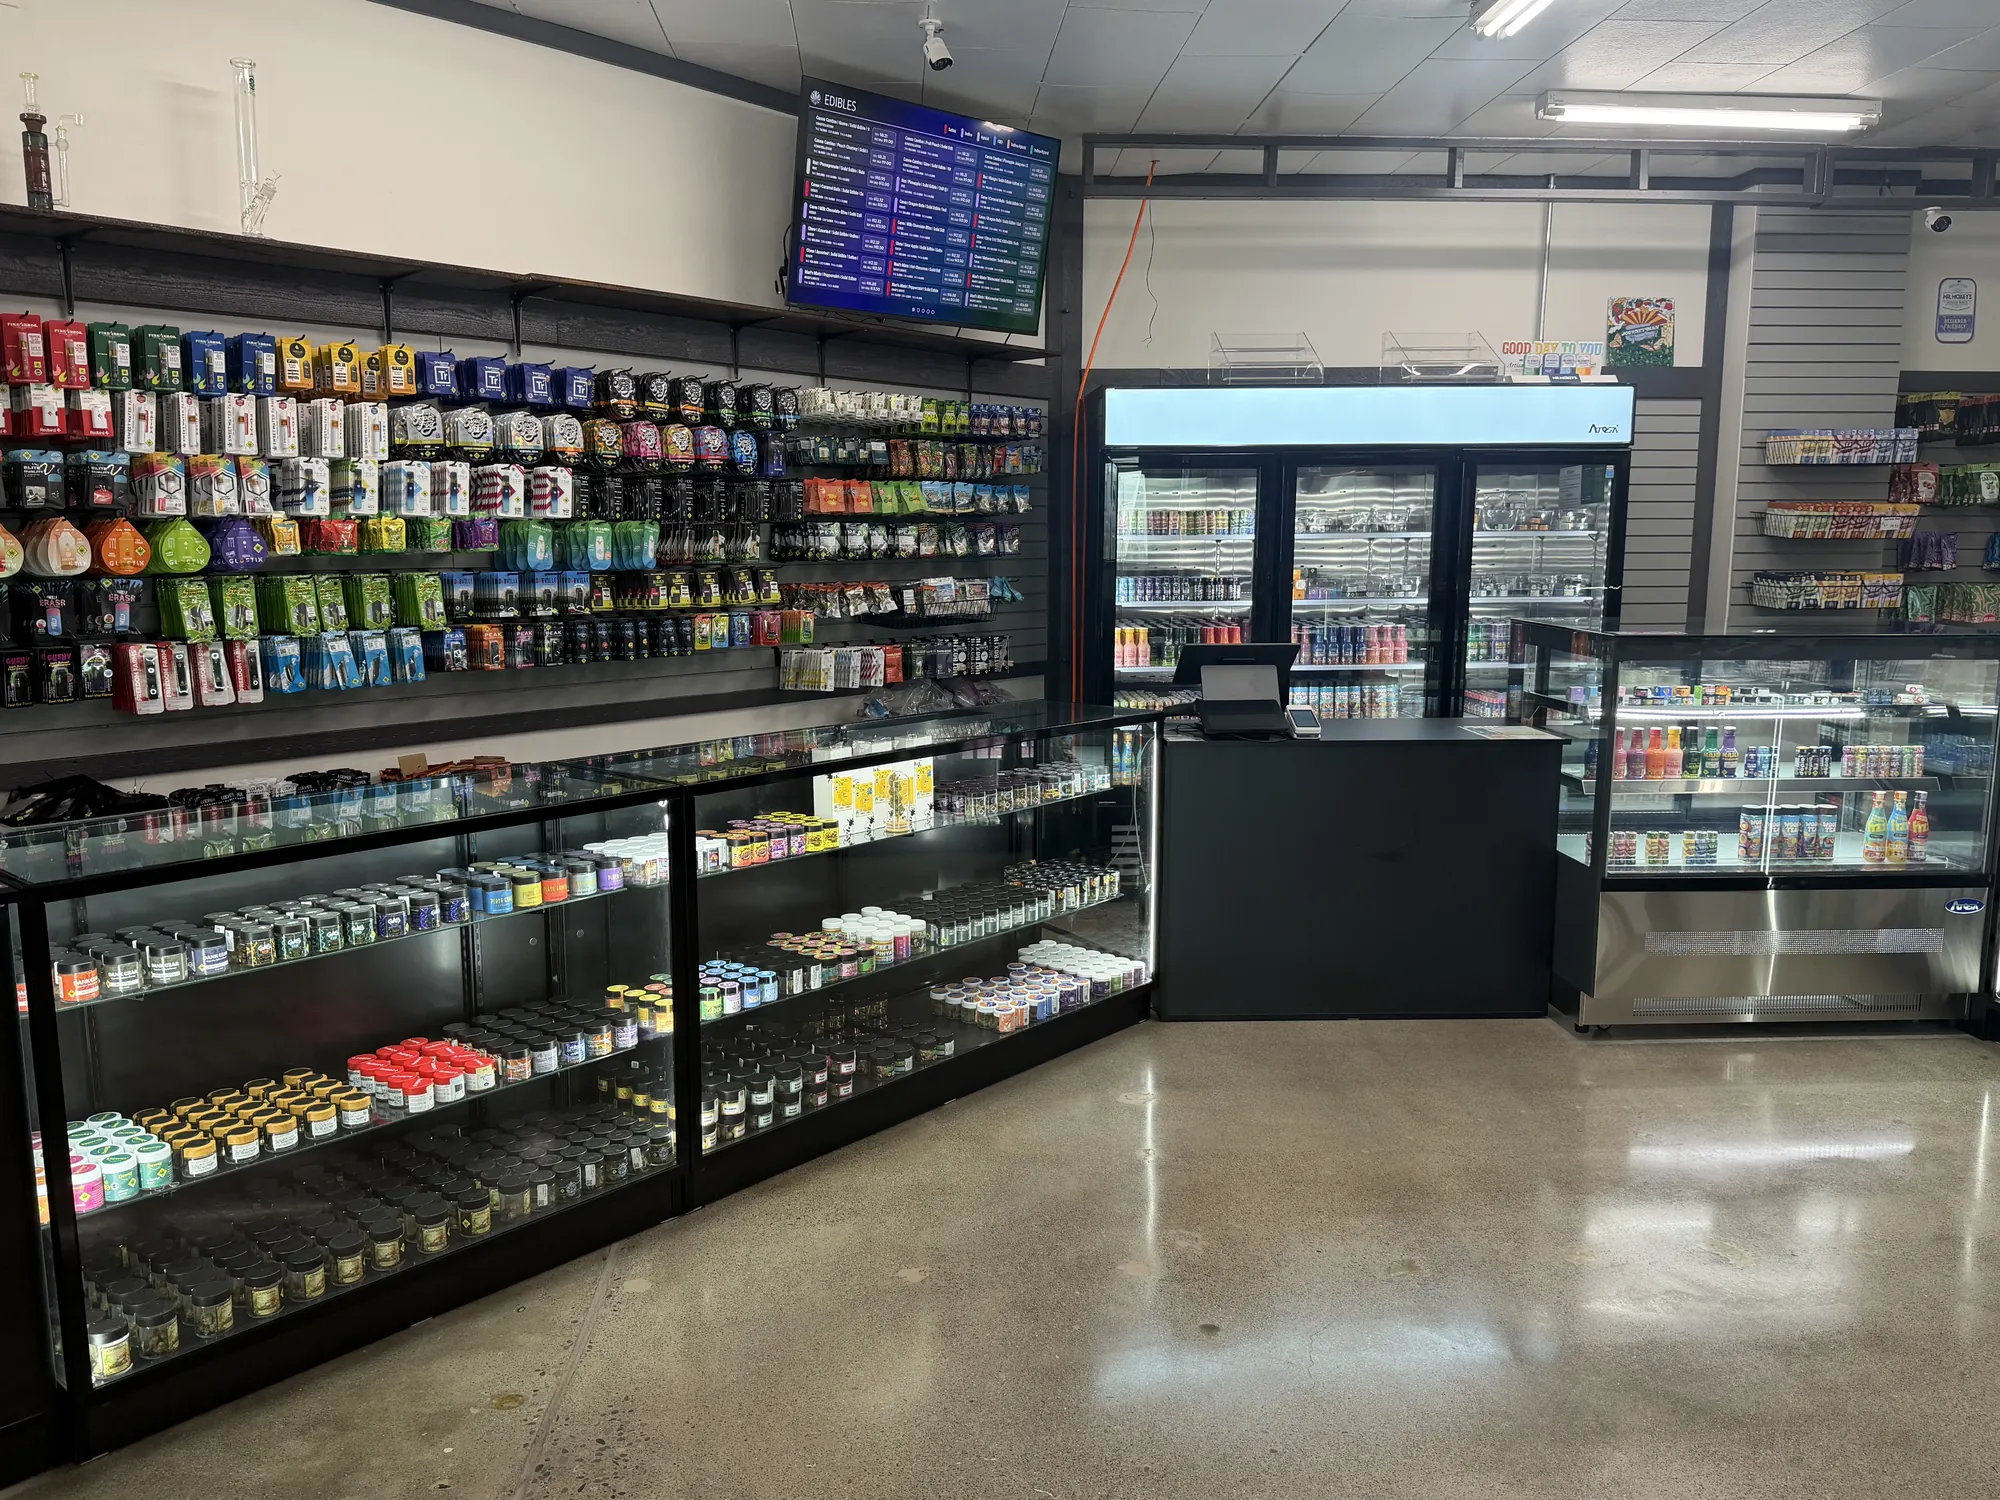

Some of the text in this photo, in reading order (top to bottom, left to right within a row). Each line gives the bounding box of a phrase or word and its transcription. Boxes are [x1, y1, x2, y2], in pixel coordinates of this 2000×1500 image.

[824, 94, 857, 112] EDIBLES
[1502, 342, 1603, 355] GOOD DAY TO YOU
[108, 593, 136, 602] ERASR
[163, 669, 172, 698] FREEDOM
[200, 665, 209, 694] FREEDOM
[236, 661, 244, 688] FREEDOM
[133, 671, 142, 702] FREEDOM
[73, 978, 87, 986] DANK
